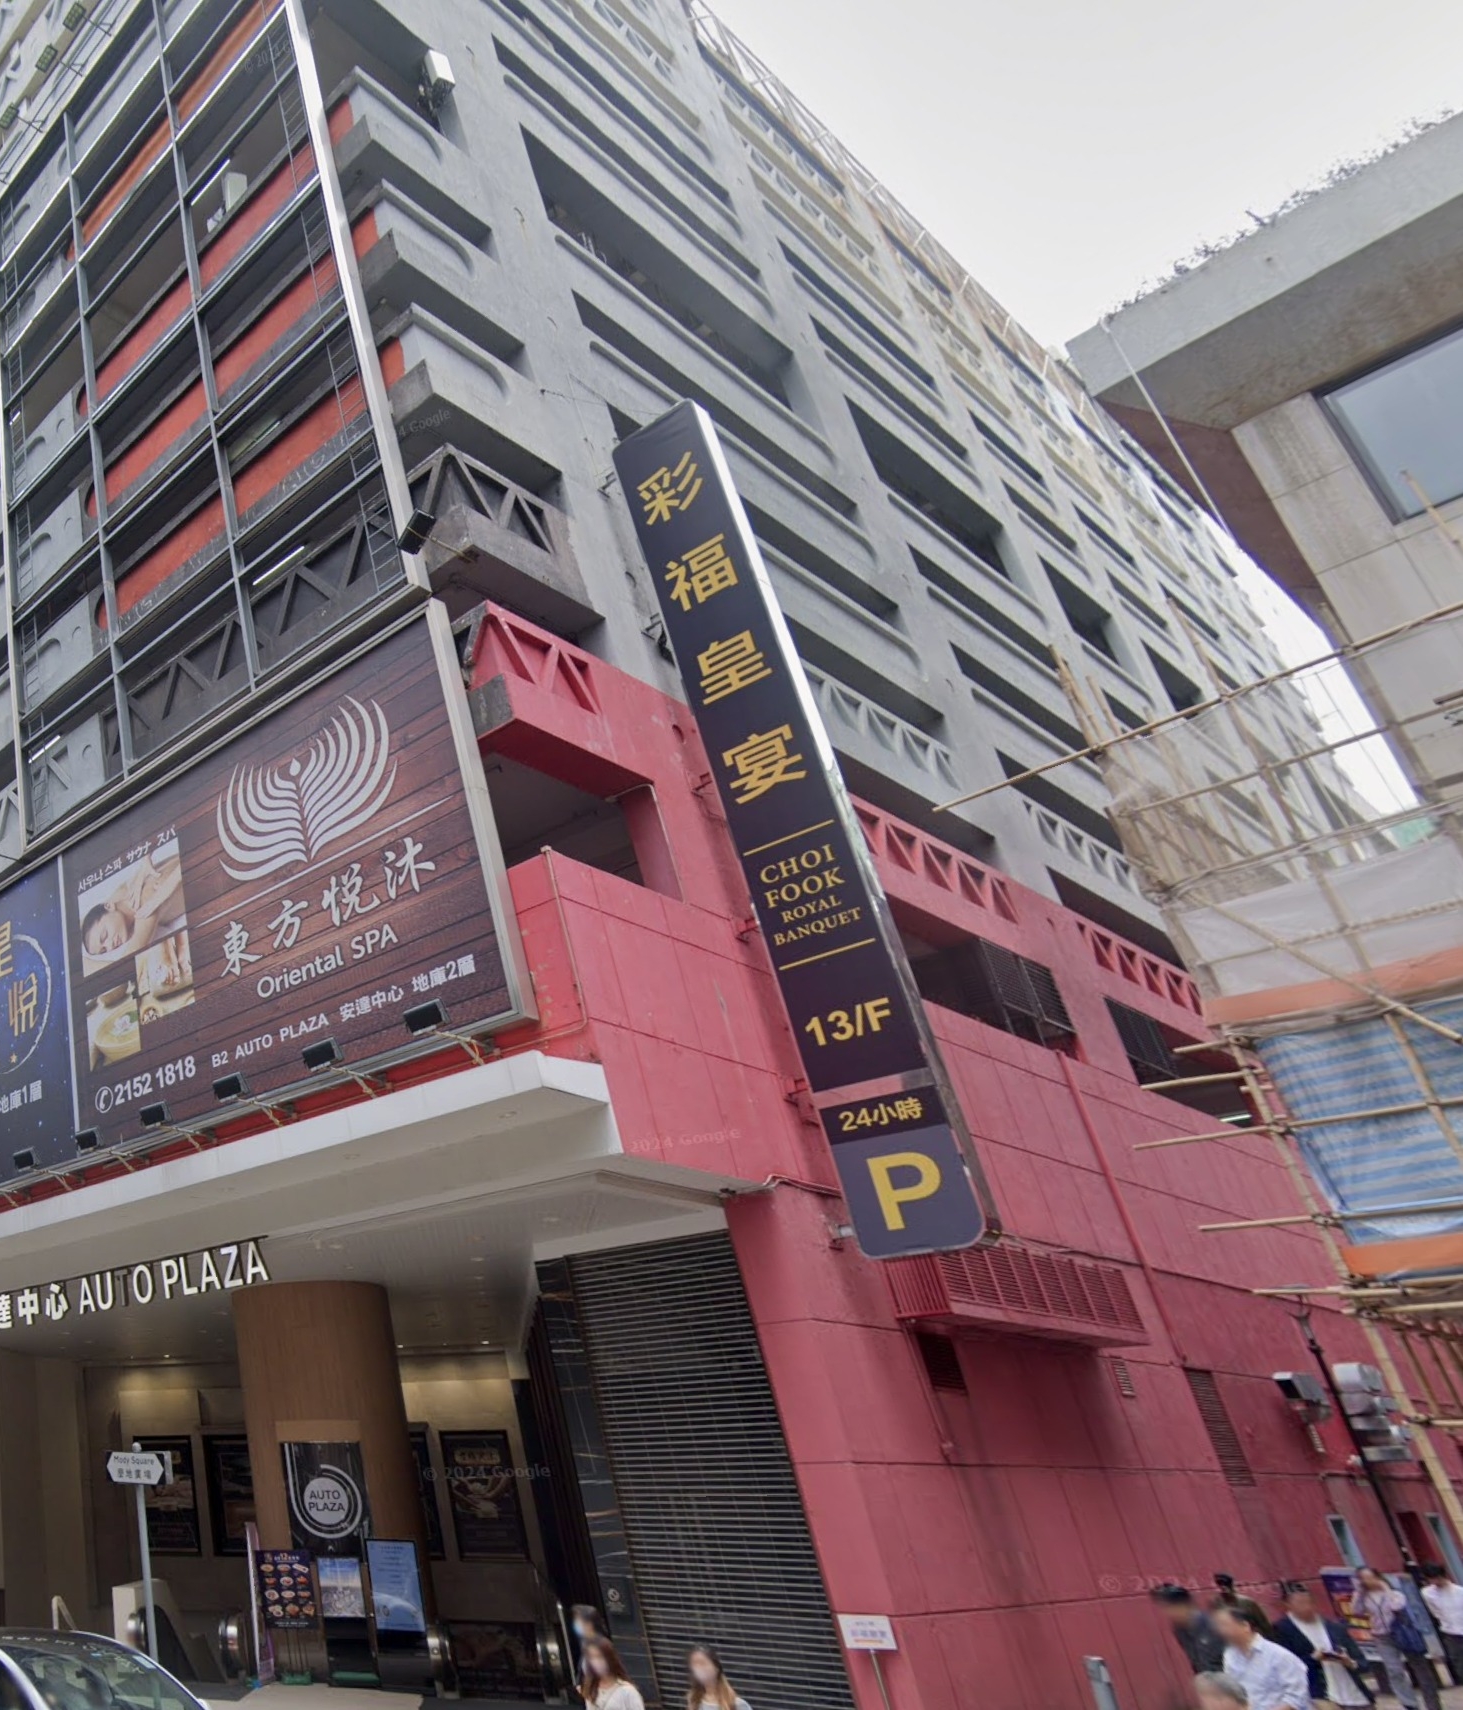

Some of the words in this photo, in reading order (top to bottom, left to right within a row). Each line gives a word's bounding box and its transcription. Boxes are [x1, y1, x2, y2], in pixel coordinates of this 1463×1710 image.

[636, 450, 807, 805] 彩福皇宴
[760, 843, 836, 883] CHOI
[764, 866, 846, 909] FOOK
[780, 894, 842, 923] ROYAL
[773, 906, 861, 946] BANQUET
[256, 945, 344, 999] Oriental
[350, 923, 399, 960] SPA
[211, 1051, 229, 1068] B2
[235, 1033, 273, 1060] AUTO
[279, 1012, 330, 1043] PLAZA
[339, 985, 405, 1023] 安達中心
[805, 997, 892, 1047] 13/F
[114, 1072, 154, 1106] 2152
[155, 1055, 197, 1089] 1818
[839, 1097, 924, 1132] 24小時
[866, 1151, 942, 1231] P
[78, 1264, 154, 1315] AUTO
[161, 1240, 271, 1300] PLAZA
[113, 1455, 130, 1465] Mody
[131, 1455, 155, 1466] Square
[308, 1501, 346, 1512] PLAZA
[309, 1489, 341, 1500] AUTO
